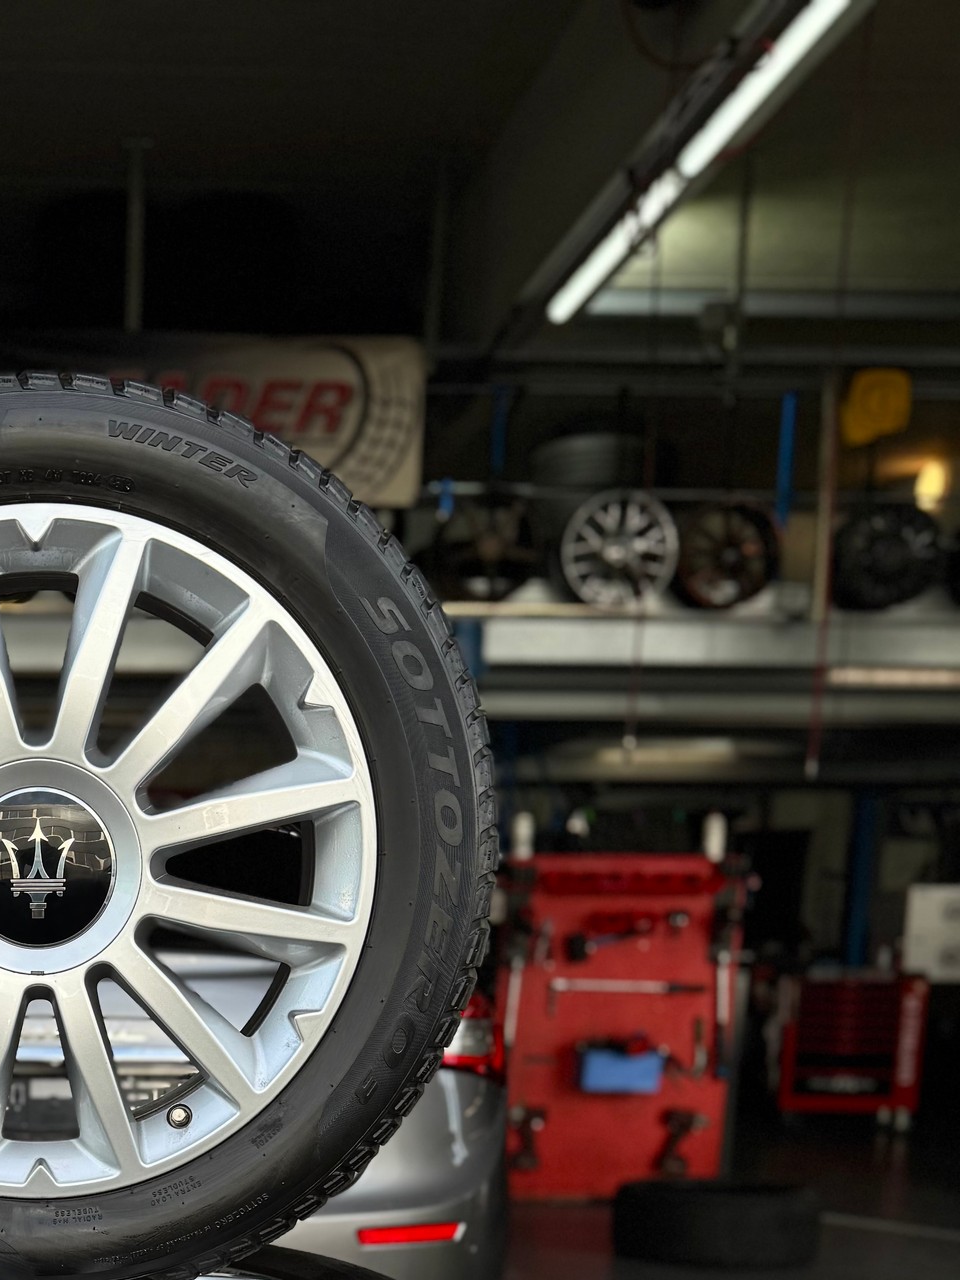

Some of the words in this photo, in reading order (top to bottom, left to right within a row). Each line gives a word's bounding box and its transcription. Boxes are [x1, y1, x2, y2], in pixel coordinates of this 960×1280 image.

[108, 420, 259, 488] WINTER
[358, 596, 463, 1070] SOTTOZERO
[151, 1175, 196, 1197] STUDLESS
[54, 1207, 99, 1217] TUBELESS
[72, 1214, 104, 1223] RADIAL
